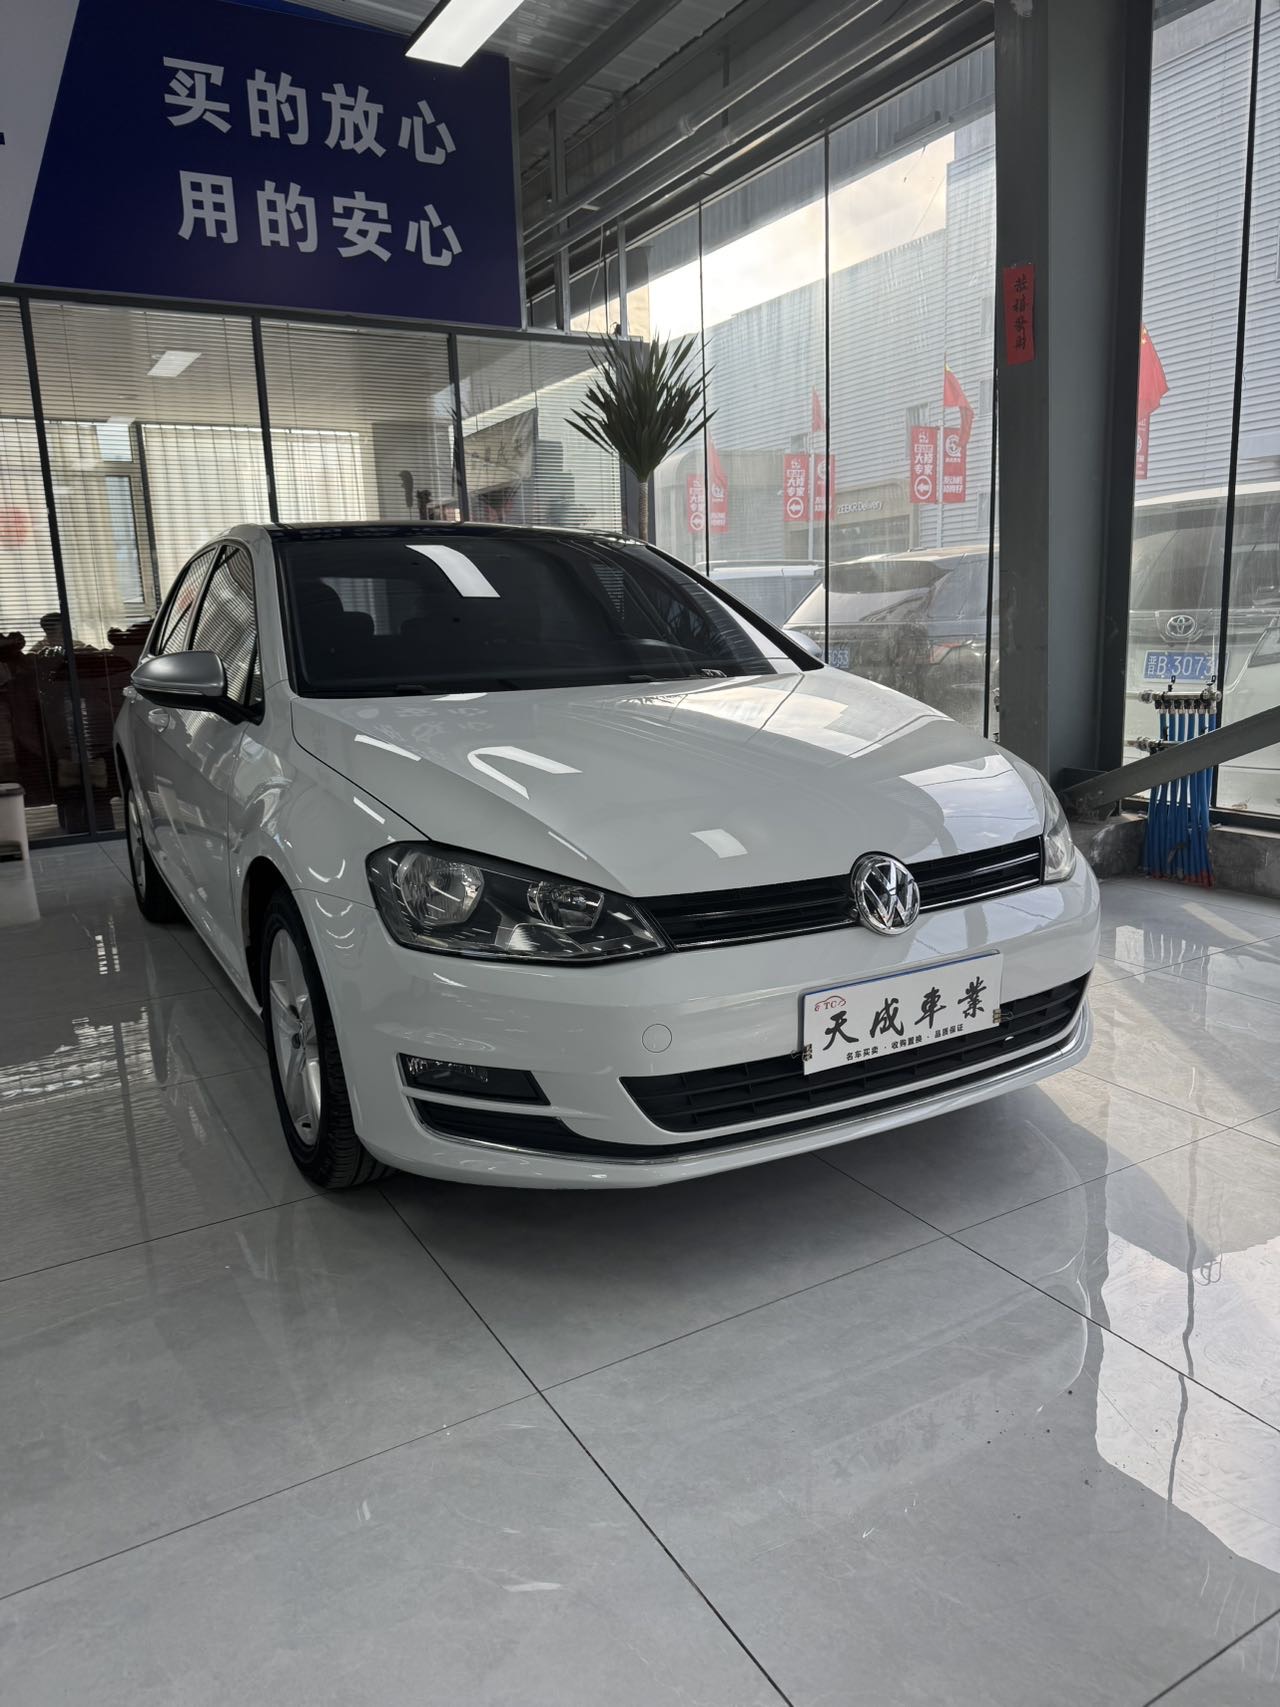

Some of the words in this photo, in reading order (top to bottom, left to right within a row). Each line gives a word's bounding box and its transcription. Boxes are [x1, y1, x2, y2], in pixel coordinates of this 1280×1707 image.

[162, 55, 457, 166] 买的放心
[178, 169, 463, 268] 用的安心
[822, 976, 988, 1051] 天成車業
[846, 1046, 879, 1062] 名车买卖
[891, 1034, 923, 1050] 收购置换
[934, 1023, 965, 1039] 品质保证
